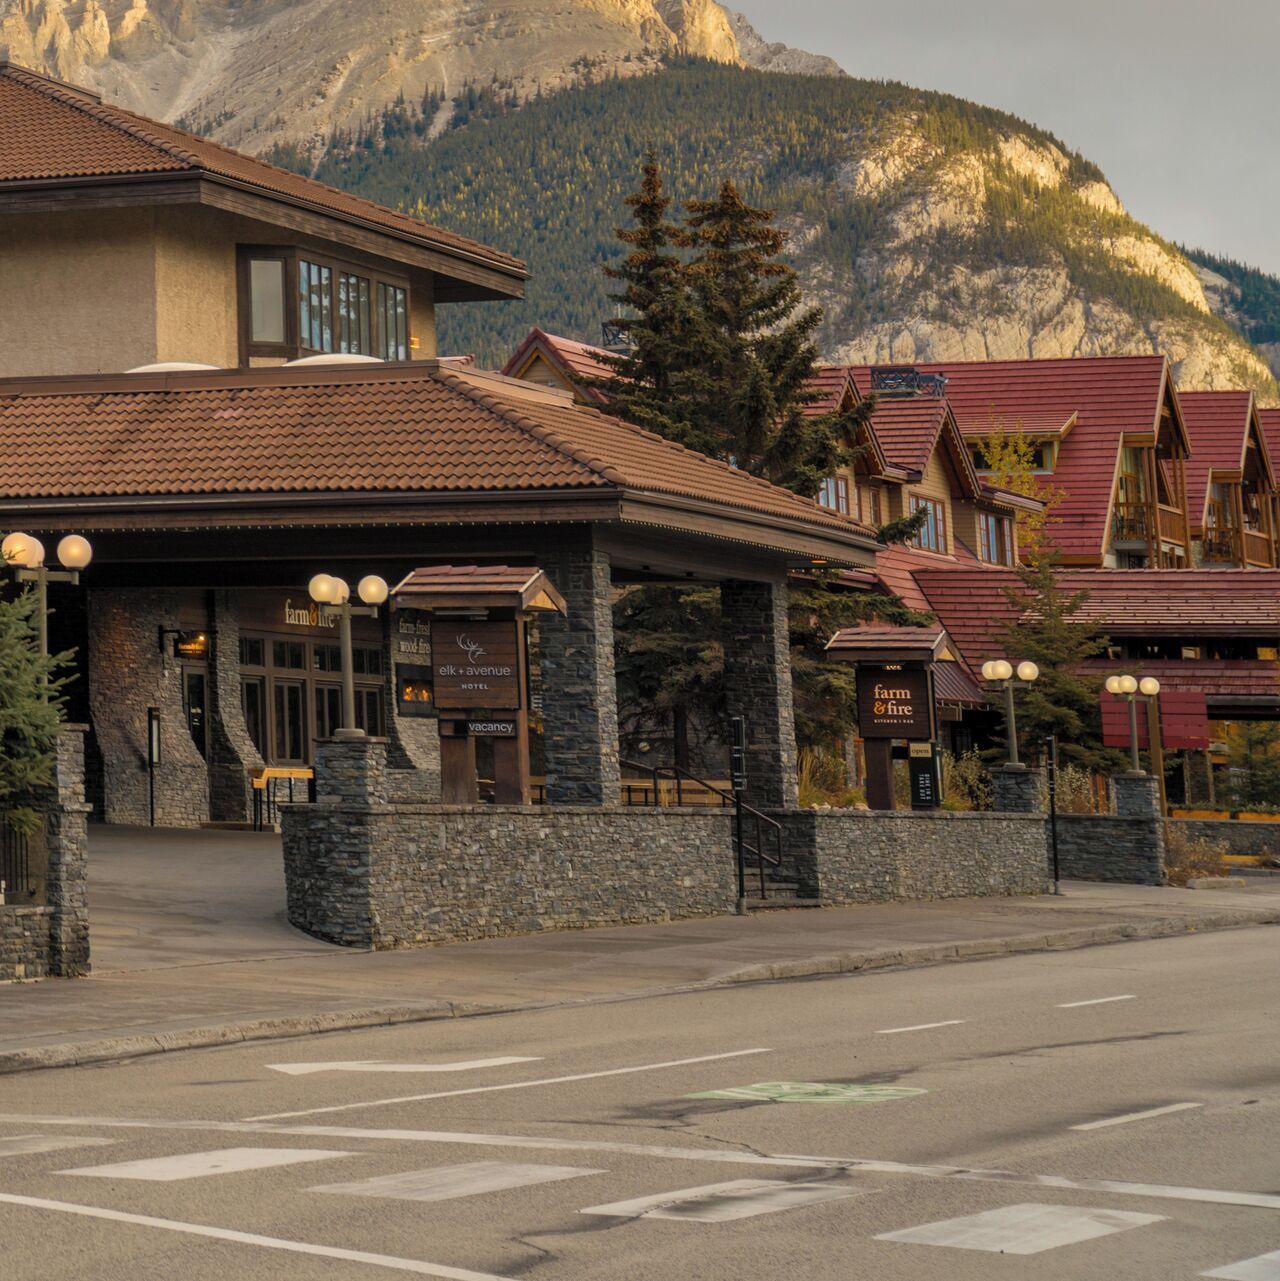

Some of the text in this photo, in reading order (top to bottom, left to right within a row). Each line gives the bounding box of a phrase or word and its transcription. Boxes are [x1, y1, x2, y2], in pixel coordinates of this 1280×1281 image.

[399, 638, 430, 654] wood-fire
[440, 665, 456, 676] elk
[466, 667, 511, 676] avenue
[874, 684, 911, 699] farm
[469, 722, 513, 733] vacancy
